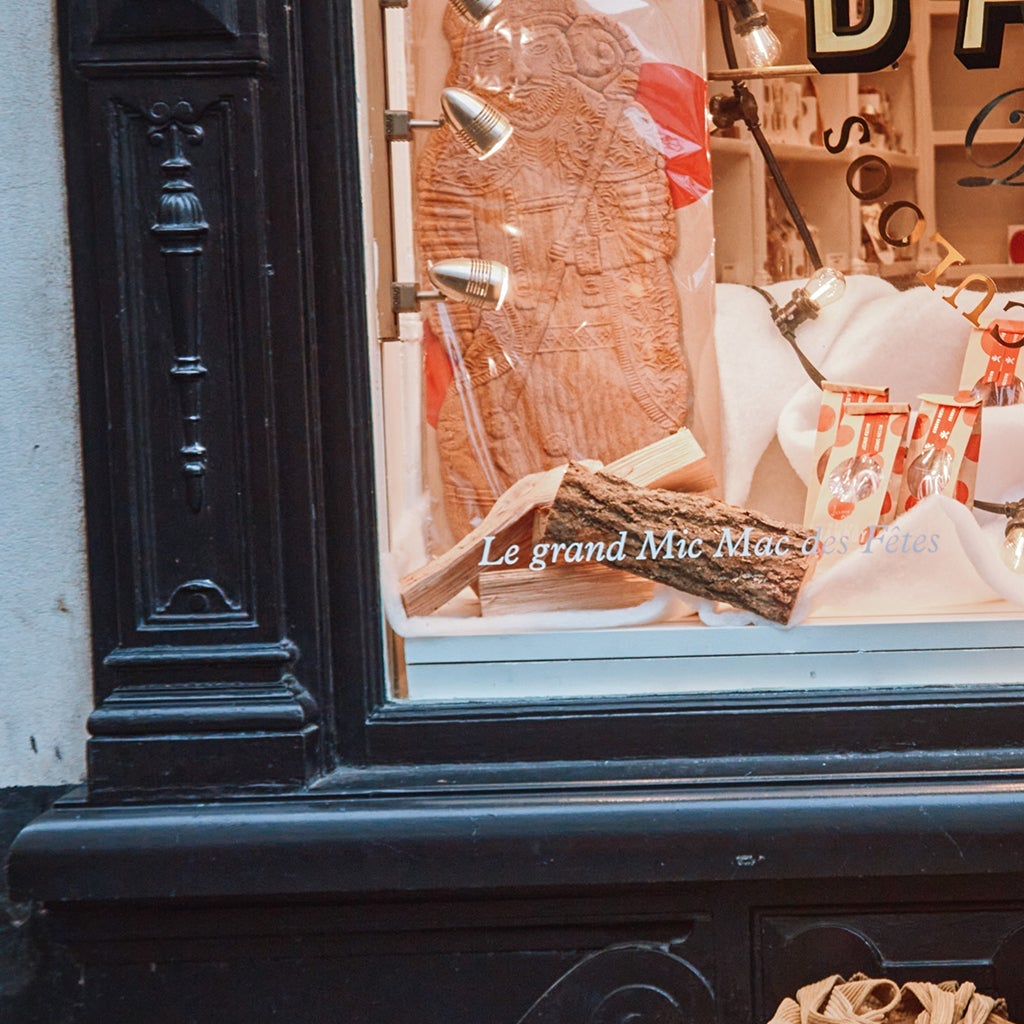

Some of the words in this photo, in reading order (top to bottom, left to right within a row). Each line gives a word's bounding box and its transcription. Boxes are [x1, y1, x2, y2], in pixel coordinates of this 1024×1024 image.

[478, 535, 520, 566] Le
[531, 531, 627, 571] grand
[635, 528, 702, 560] Mic
[715, 526, 790, 557] Mac
[801, 525, 849, 556] des
[863, 523, 940, 554] Fêtes
